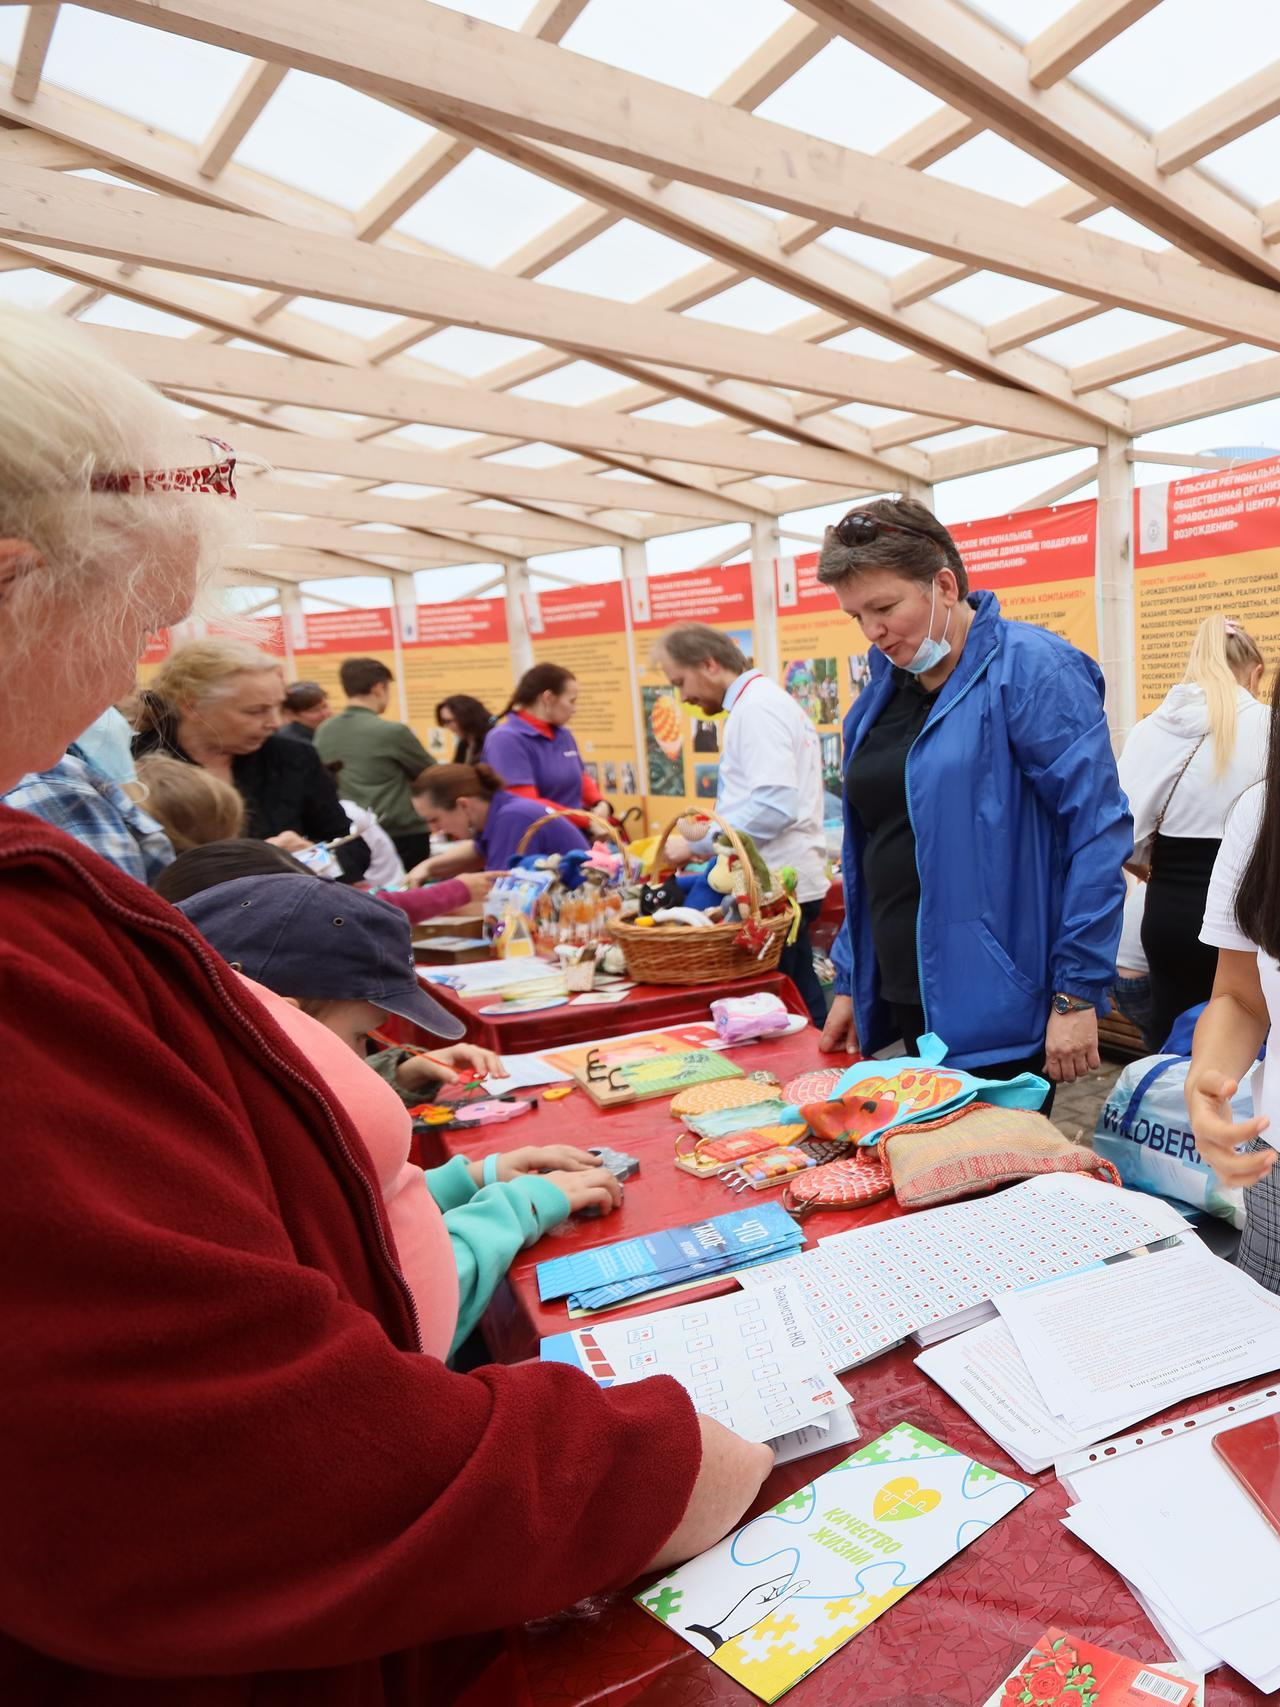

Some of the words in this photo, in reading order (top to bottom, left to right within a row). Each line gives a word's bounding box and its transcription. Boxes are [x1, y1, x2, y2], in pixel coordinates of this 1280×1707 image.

[1173, 488, 1242, 511] ОБЩЕСТВЕННАЯ
[1174, 479, 1218, 496] ТУЛЬСКАЯ
[1245, 497, 1276, 512] ЦЕНТР
[690, 1222, 727, 1250] ТАКОЕ
[732, 1219, 769, 1244] ЧТО
[822, 1506, 904, 1554] КАЧЕСТВО
[807, 1525, 875, 1566] ЖИЗНИ
